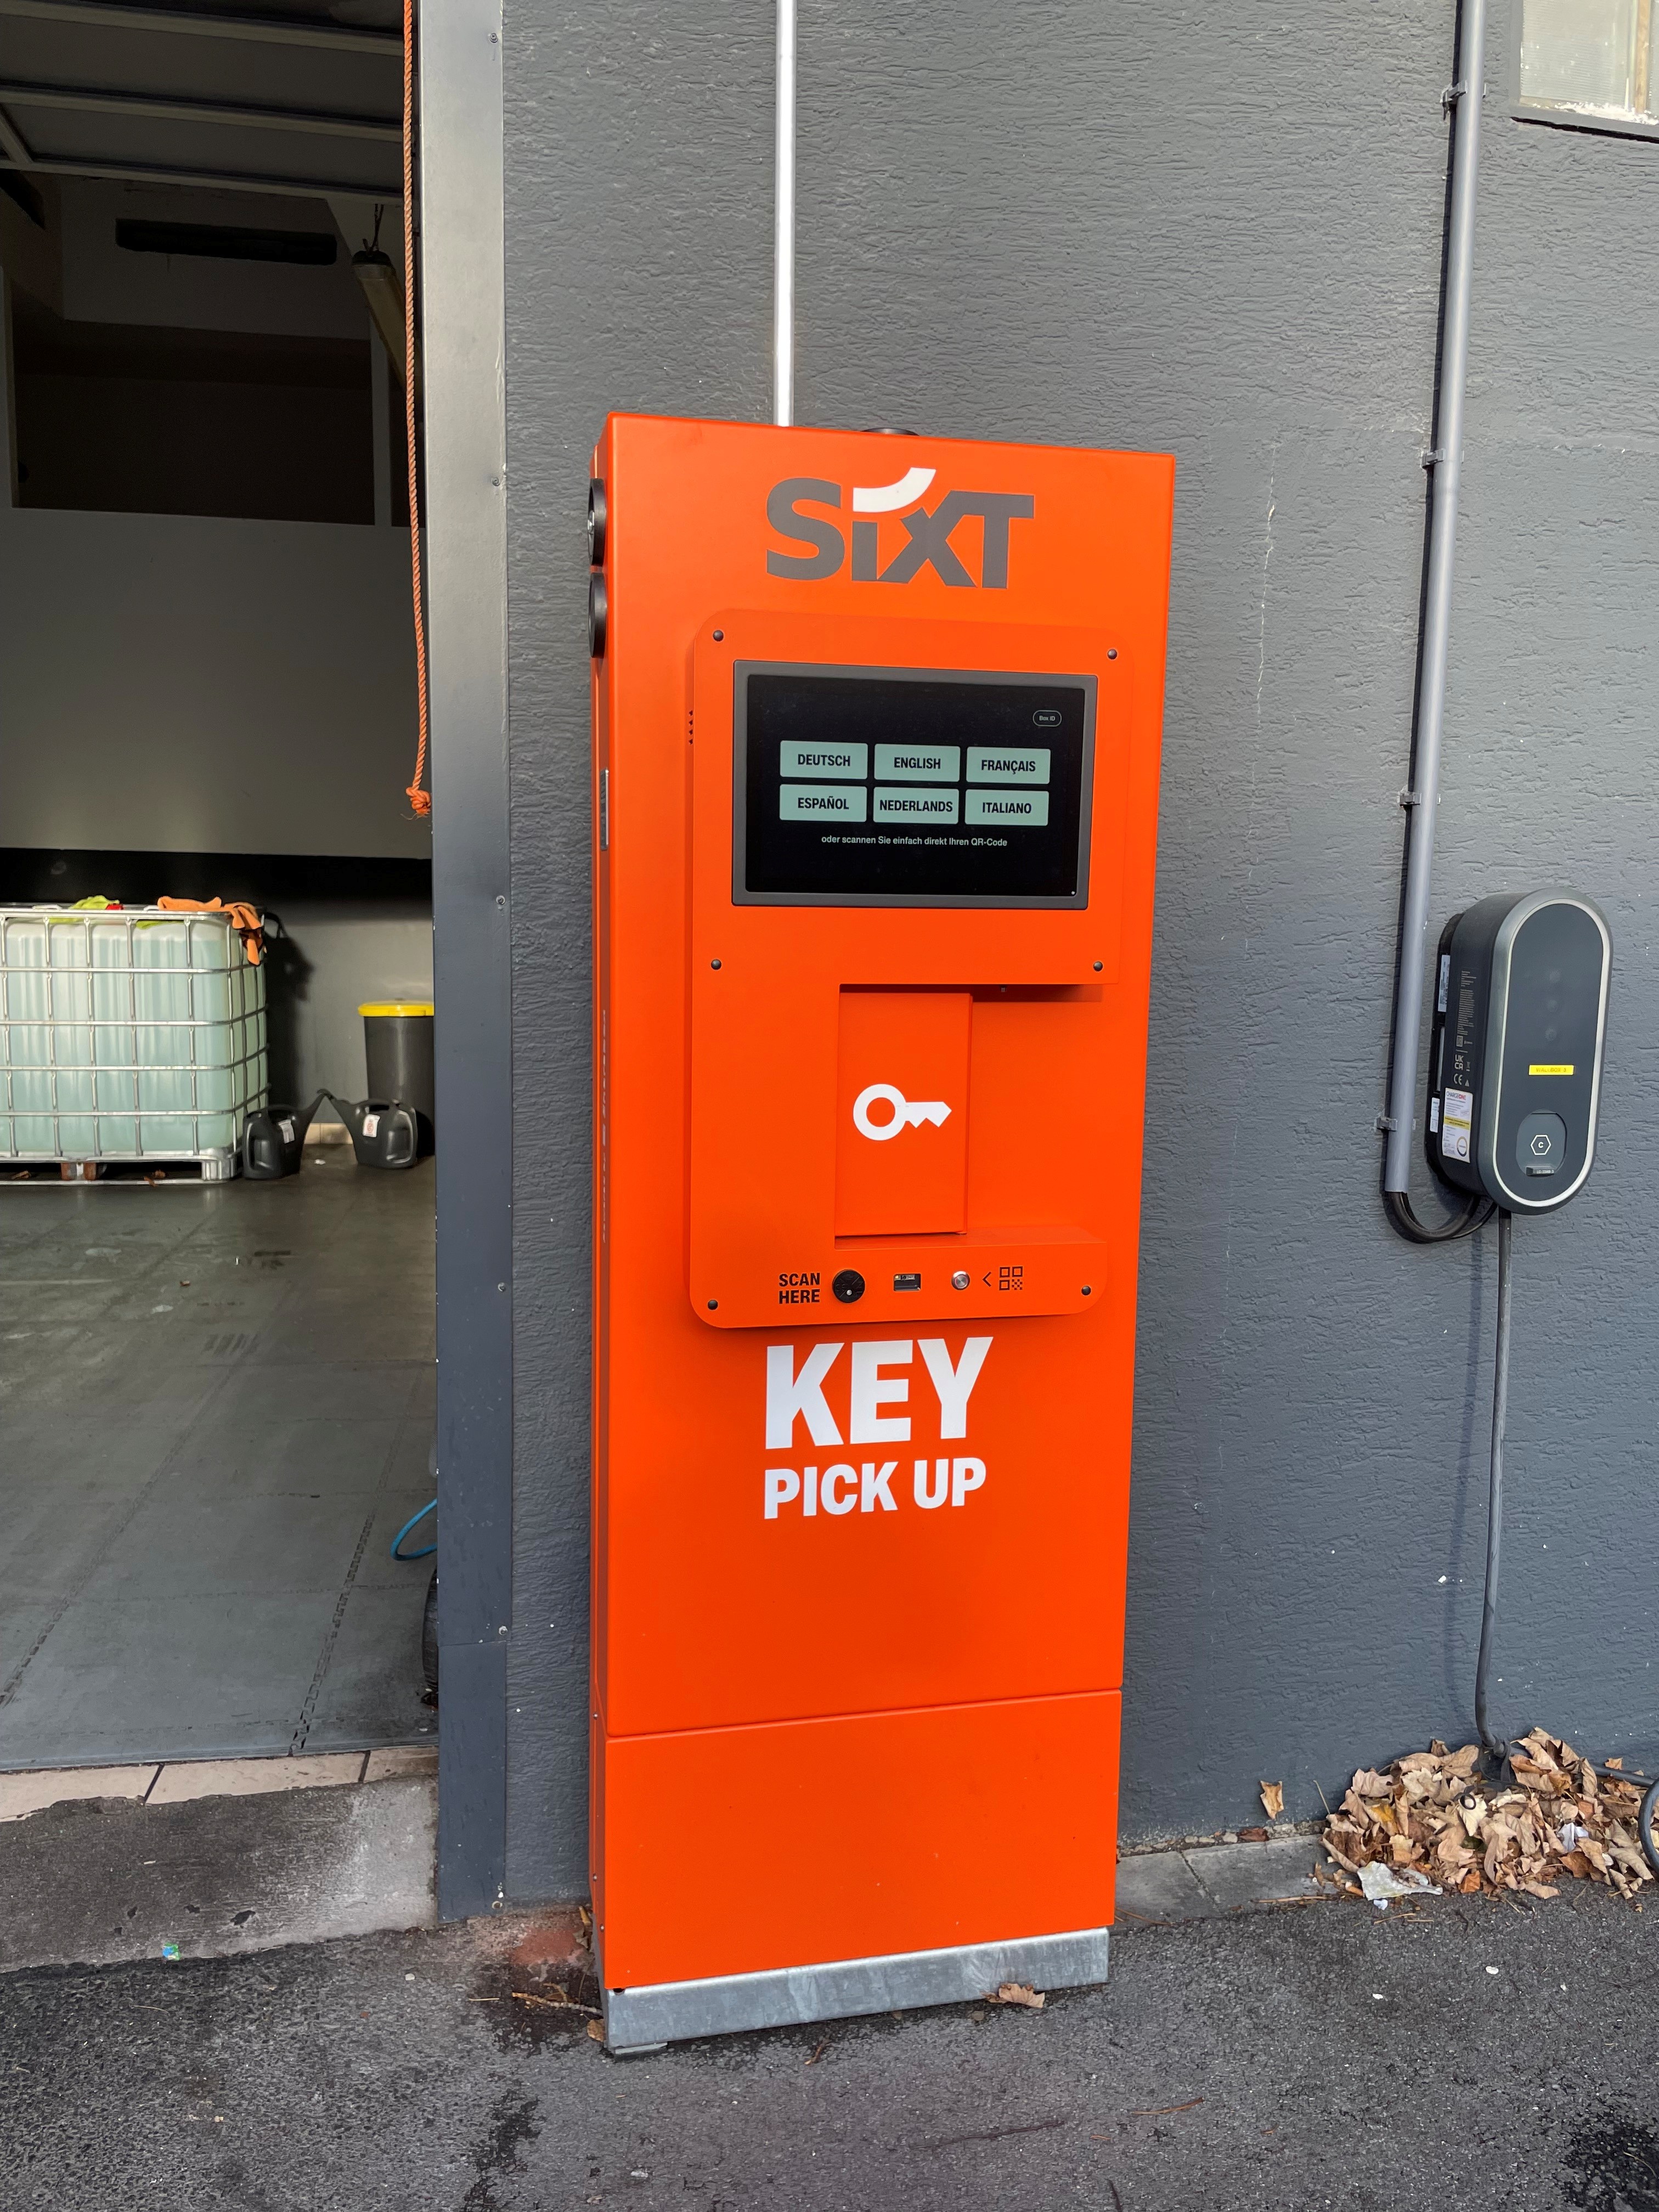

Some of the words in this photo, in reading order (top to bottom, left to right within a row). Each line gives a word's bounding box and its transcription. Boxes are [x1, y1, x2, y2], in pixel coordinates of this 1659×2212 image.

[797, 753, 851, 767] DEUTSCH
[893, 757, 941, 770] ENGLISH
[981, 759, 1036, 775] FRANÇAIS
[797, 795, 850, 810] ESPAÑOL
[879, 799, 953, 812] NEDERLANDS
[981, 802, 1032, 814] ITALIANO
[821, 835, 840, 844] oder
[878, 836, 891, 844] Sie
[893, 836, 922, 845] einfach
[924, 837, 947, 845] direkt
[949, 837, 969, 846] Ihren
[970, 838, 1008, 847] QR-Code
[778, 1272, 821, 1287] SCAN
[778, 1289, 821, 1305] HERE
[765, 1336, 994, 1449] KEY
[765, 1462, 899, 1519] PICK
[913, 1457, 987, 1509] UP
